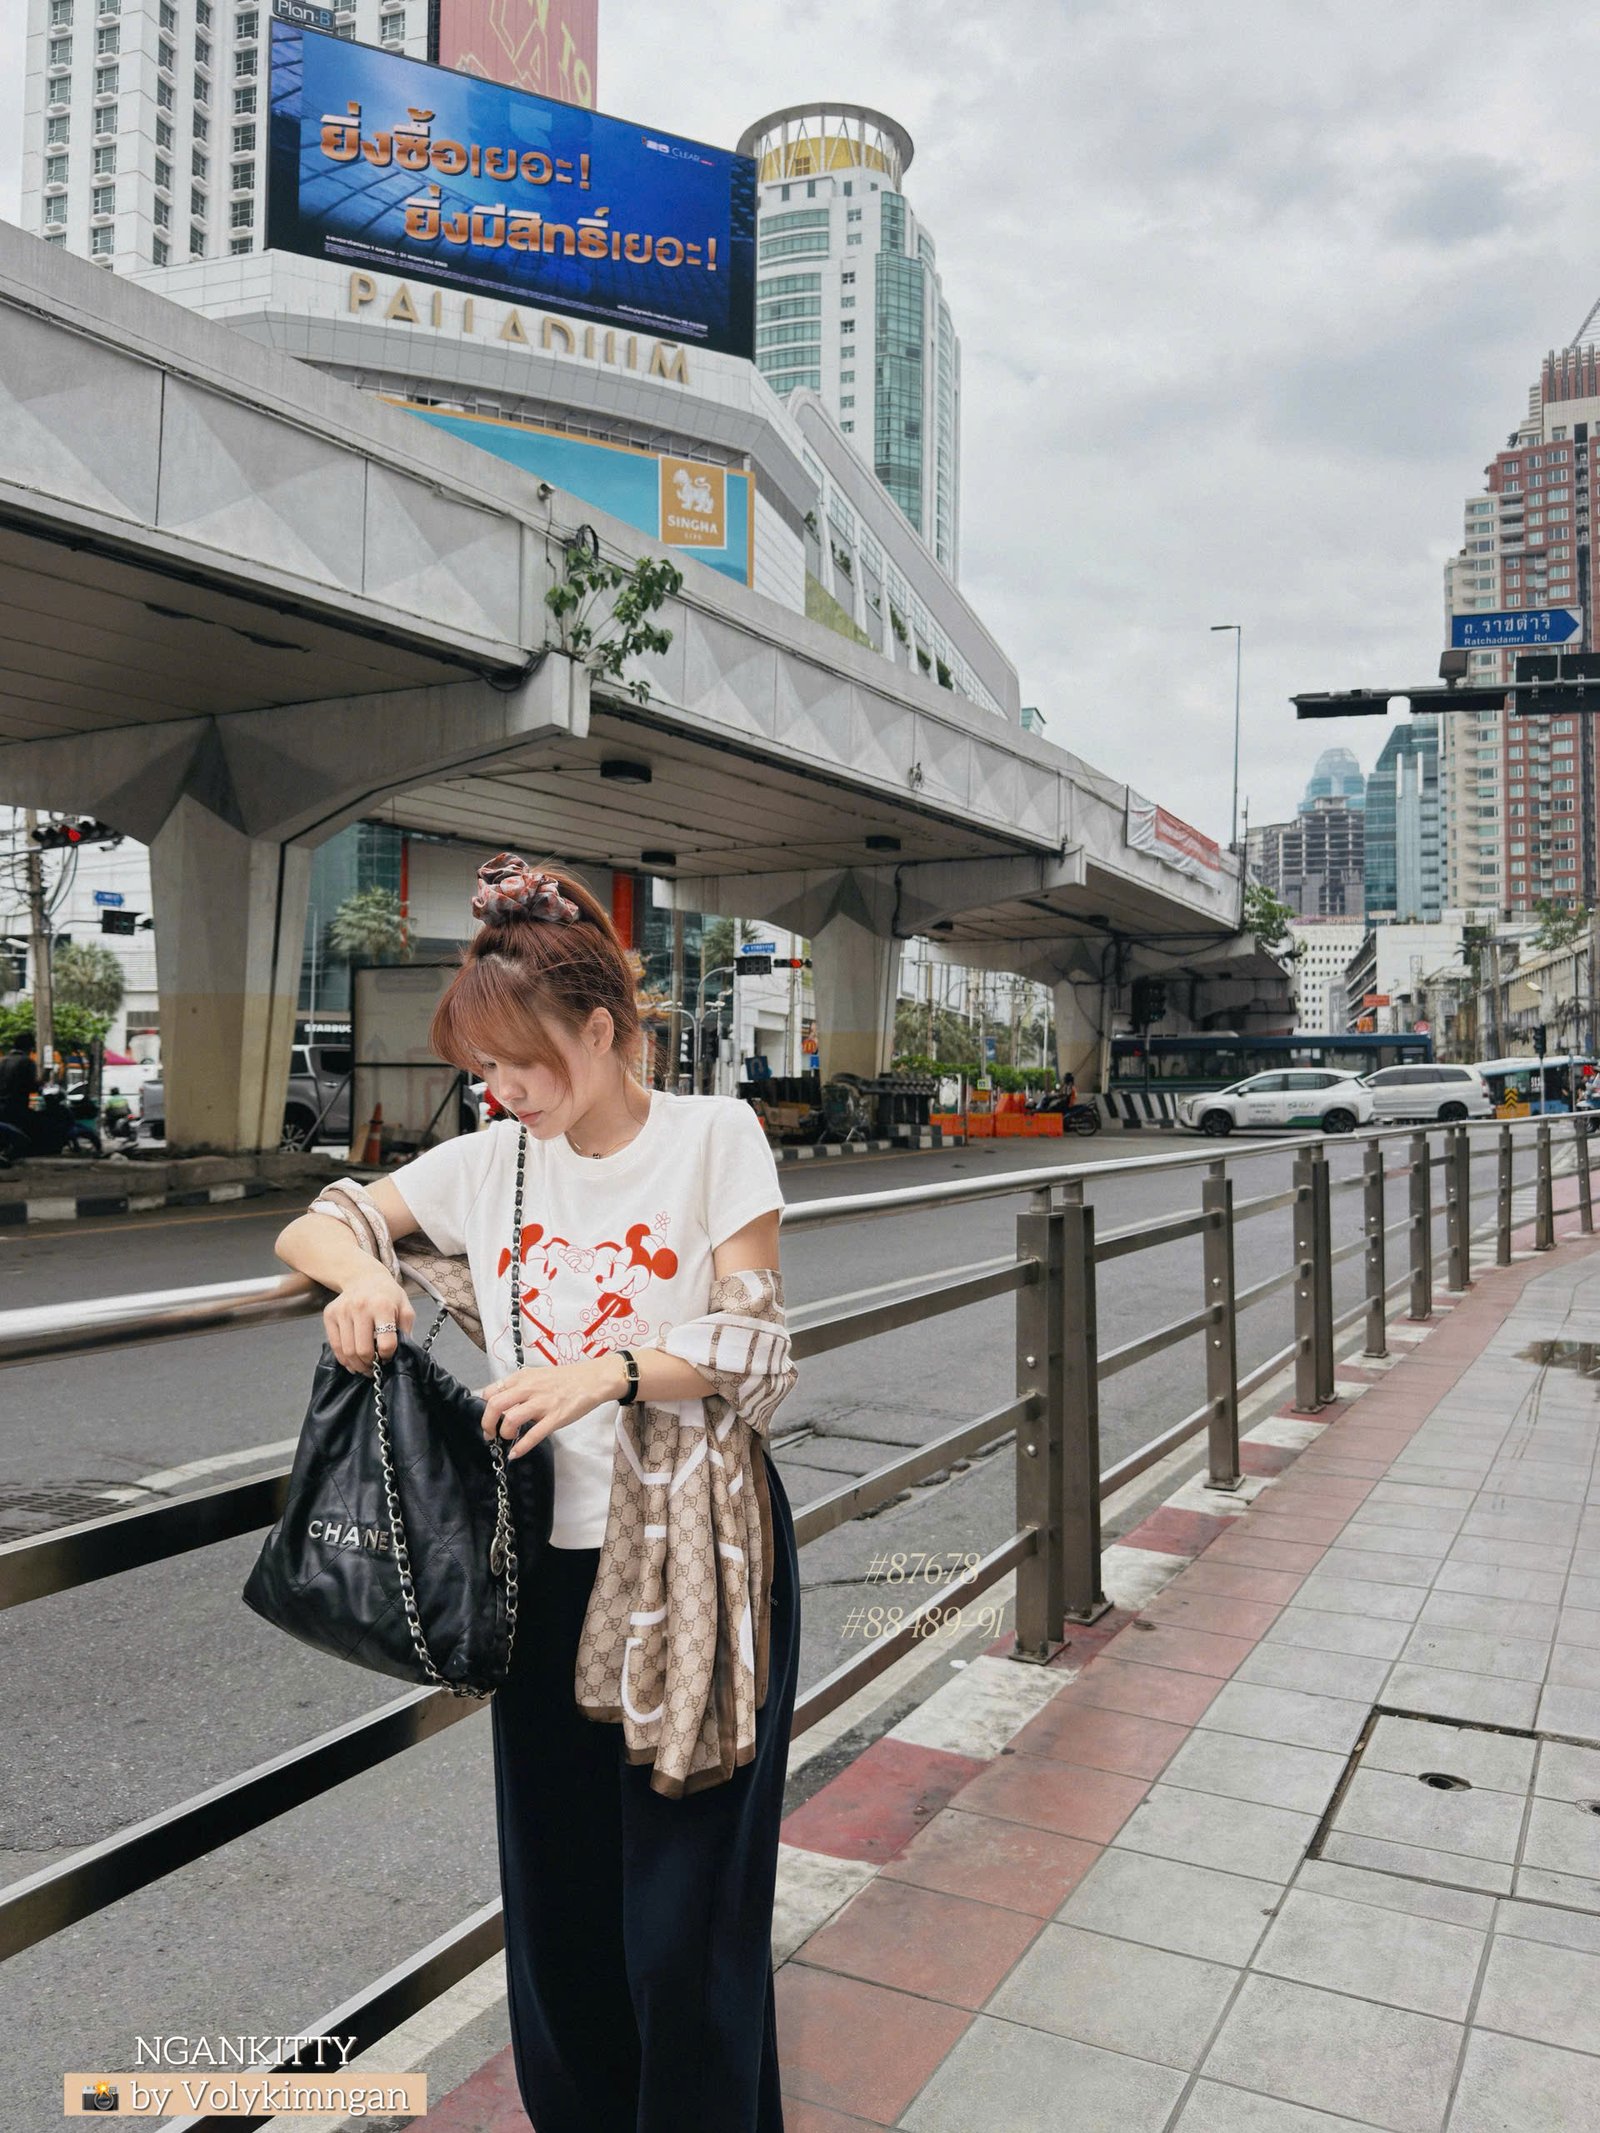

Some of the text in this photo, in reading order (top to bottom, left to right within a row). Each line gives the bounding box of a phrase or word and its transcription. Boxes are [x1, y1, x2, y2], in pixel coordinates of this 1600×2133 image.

[319, 101, 592, 190] ยิ่งซื้อเยอะ!
[403, 184, 718, 272] ยิ่งมีสิทธิ์เยอะ!
[667, 515, 718, 534] SINGHA
[1464, 634, 1524, 646] Ratchadamri
[308, 1520, 397, 1551] CHANE
